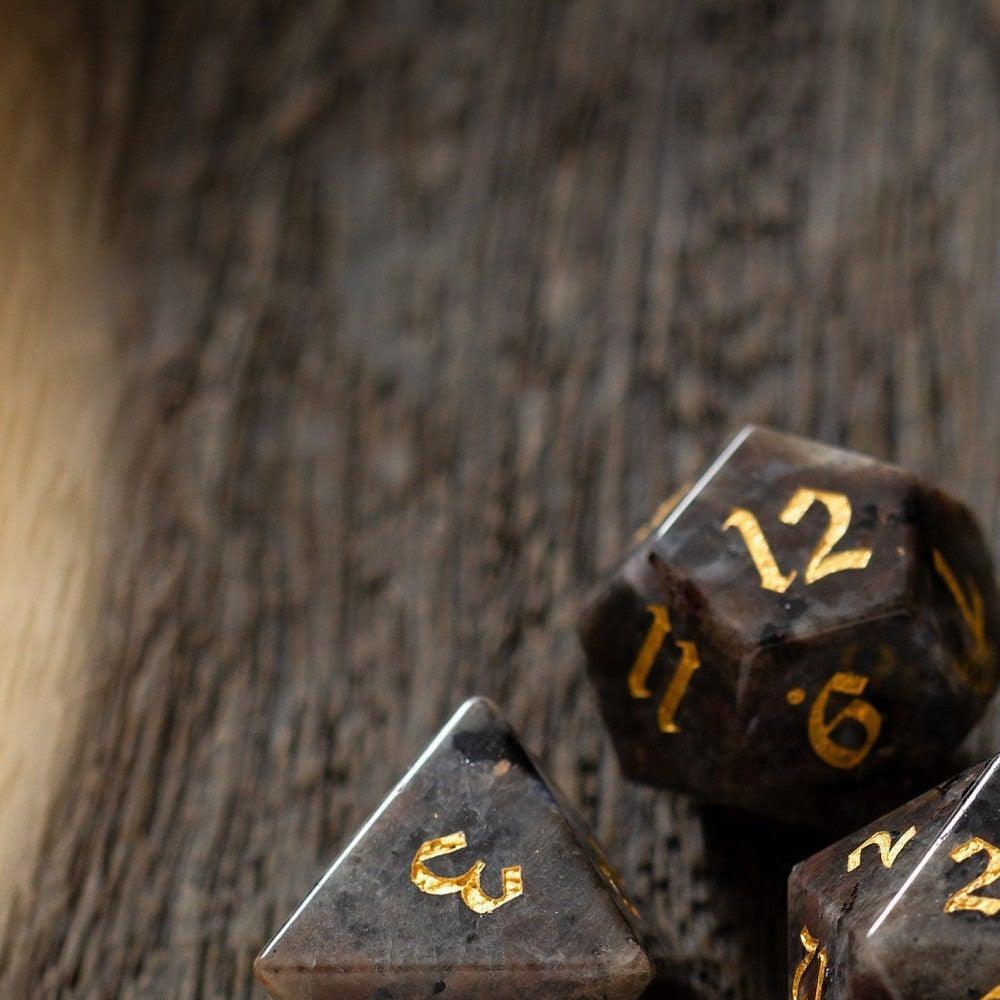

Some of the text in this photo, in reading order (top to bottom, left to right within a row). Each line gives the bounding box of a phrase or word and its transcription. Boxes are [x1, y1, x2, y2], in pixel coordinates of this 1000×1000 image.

[721, 487, 873, 594] 12
[628, 603, 701, 735] 11
[410, 831, 524, 914] 3
[848, 825, 917, 873] 2
